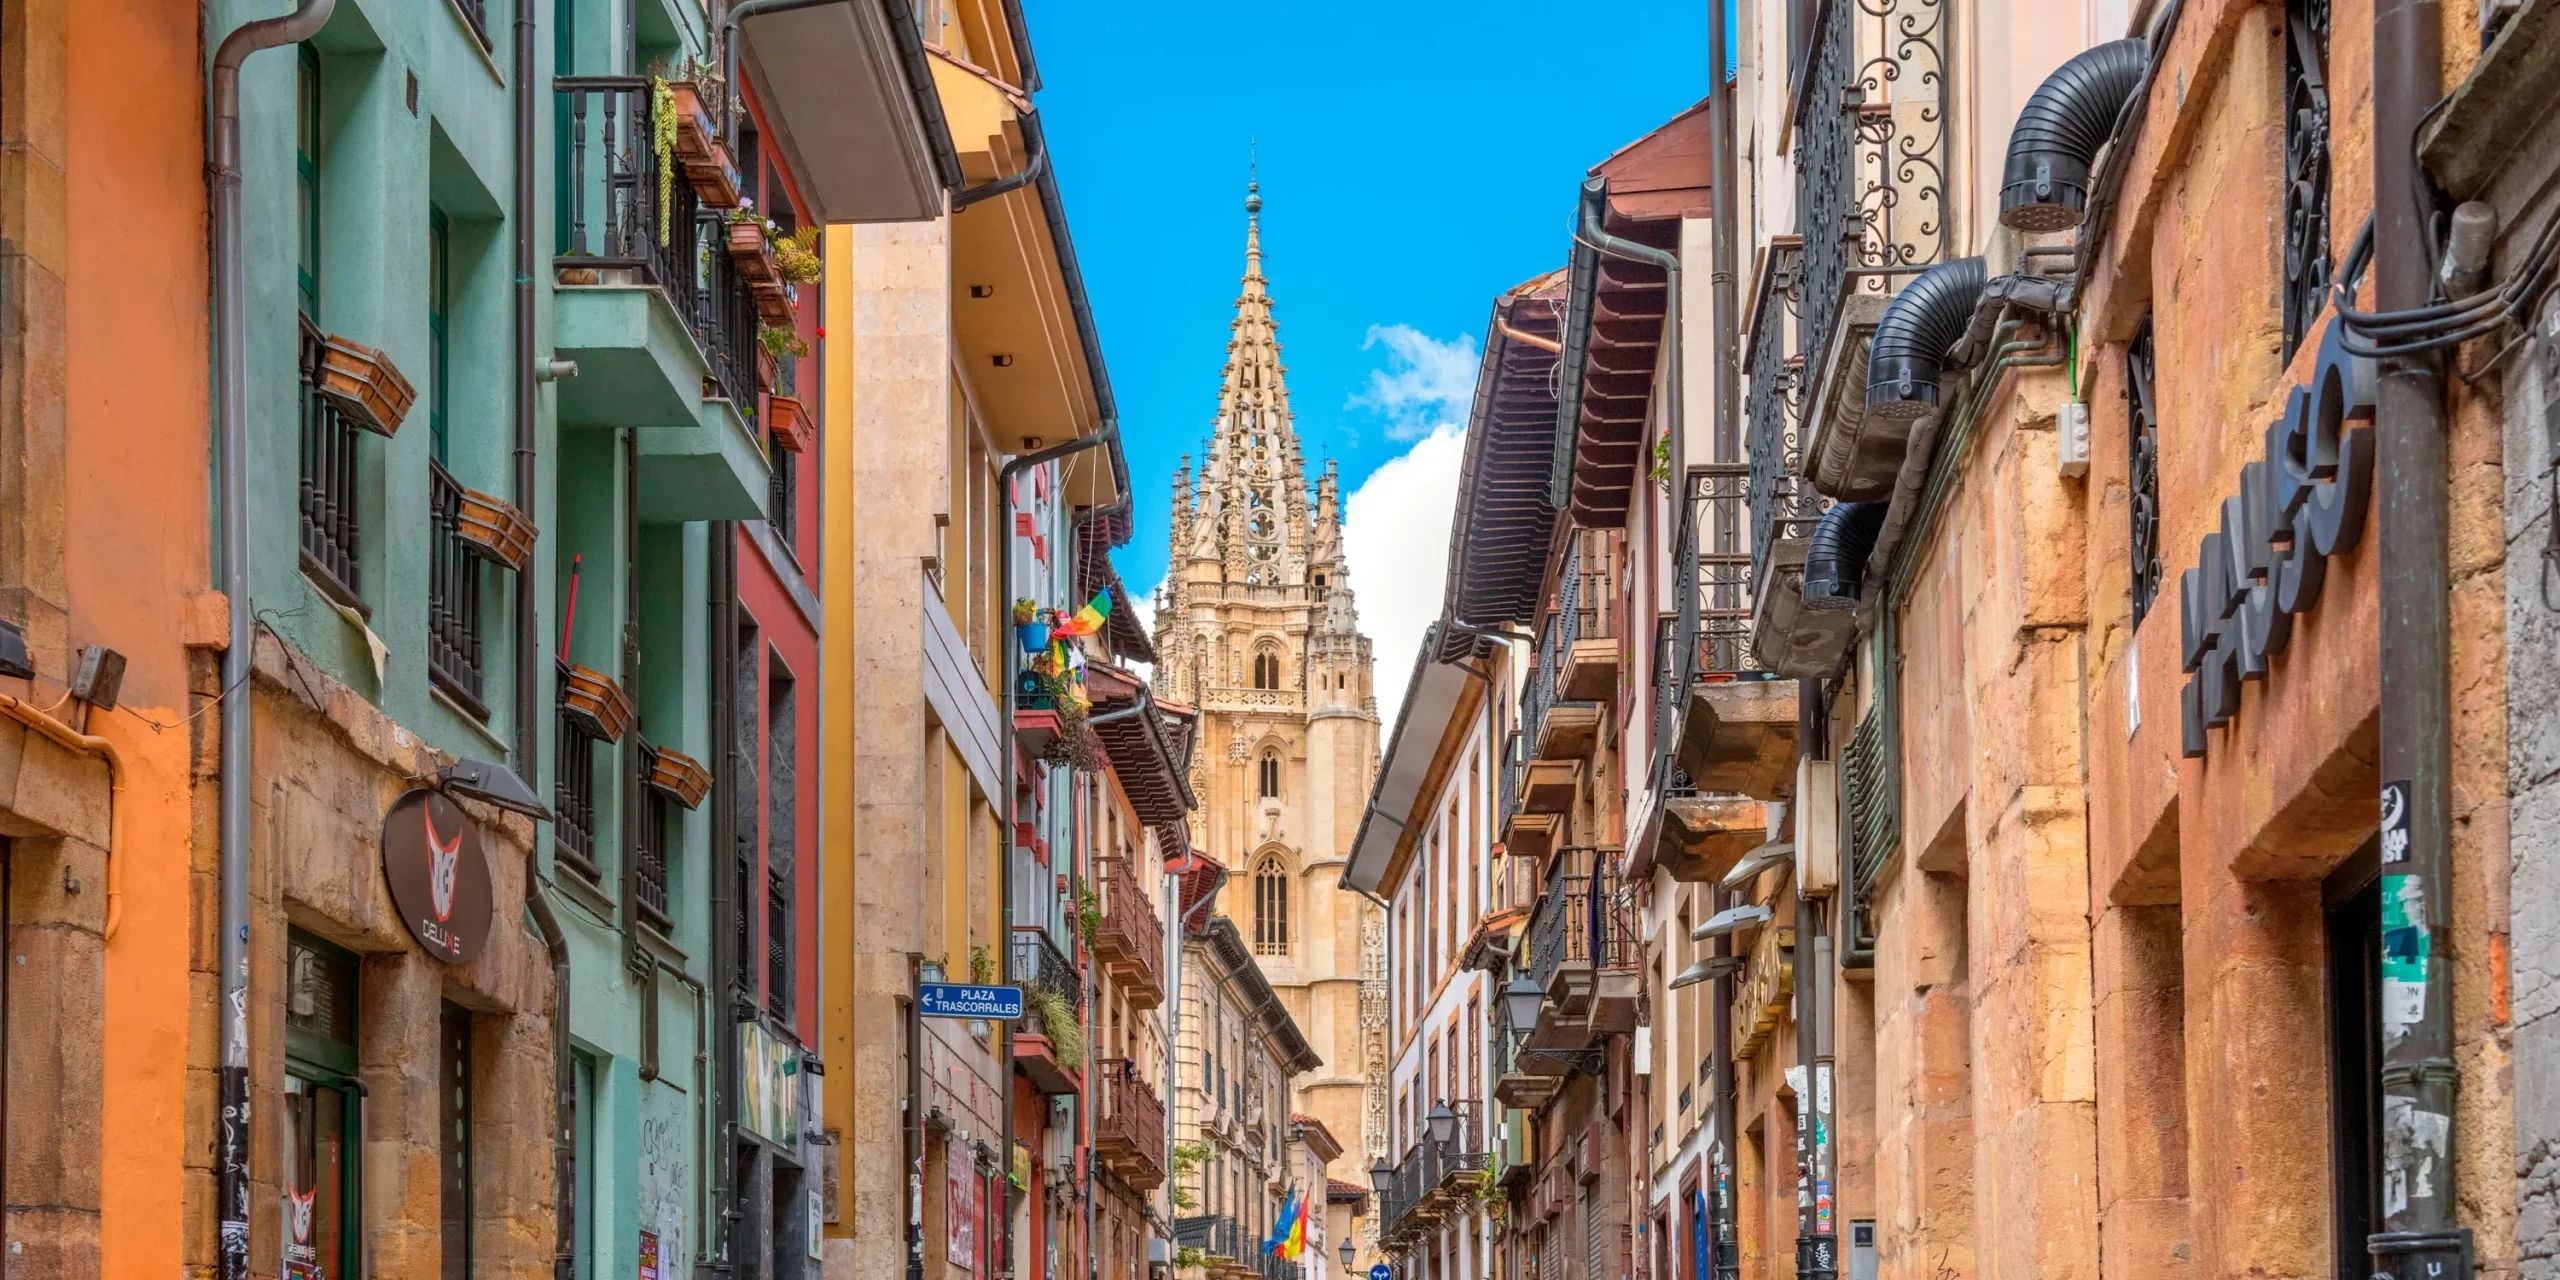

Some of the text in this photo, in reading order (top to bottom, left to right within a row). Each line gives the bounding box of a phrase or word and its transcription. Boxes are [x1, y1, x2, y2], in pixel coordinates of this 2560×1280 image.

[422, 918, 461, 957] DELUXE
[961, 989, 996, 1001] PLAZA
[935, 1000, 1019, 1014] TRASCORRALES
[287, 1242, 316, 1262] DELUXE
